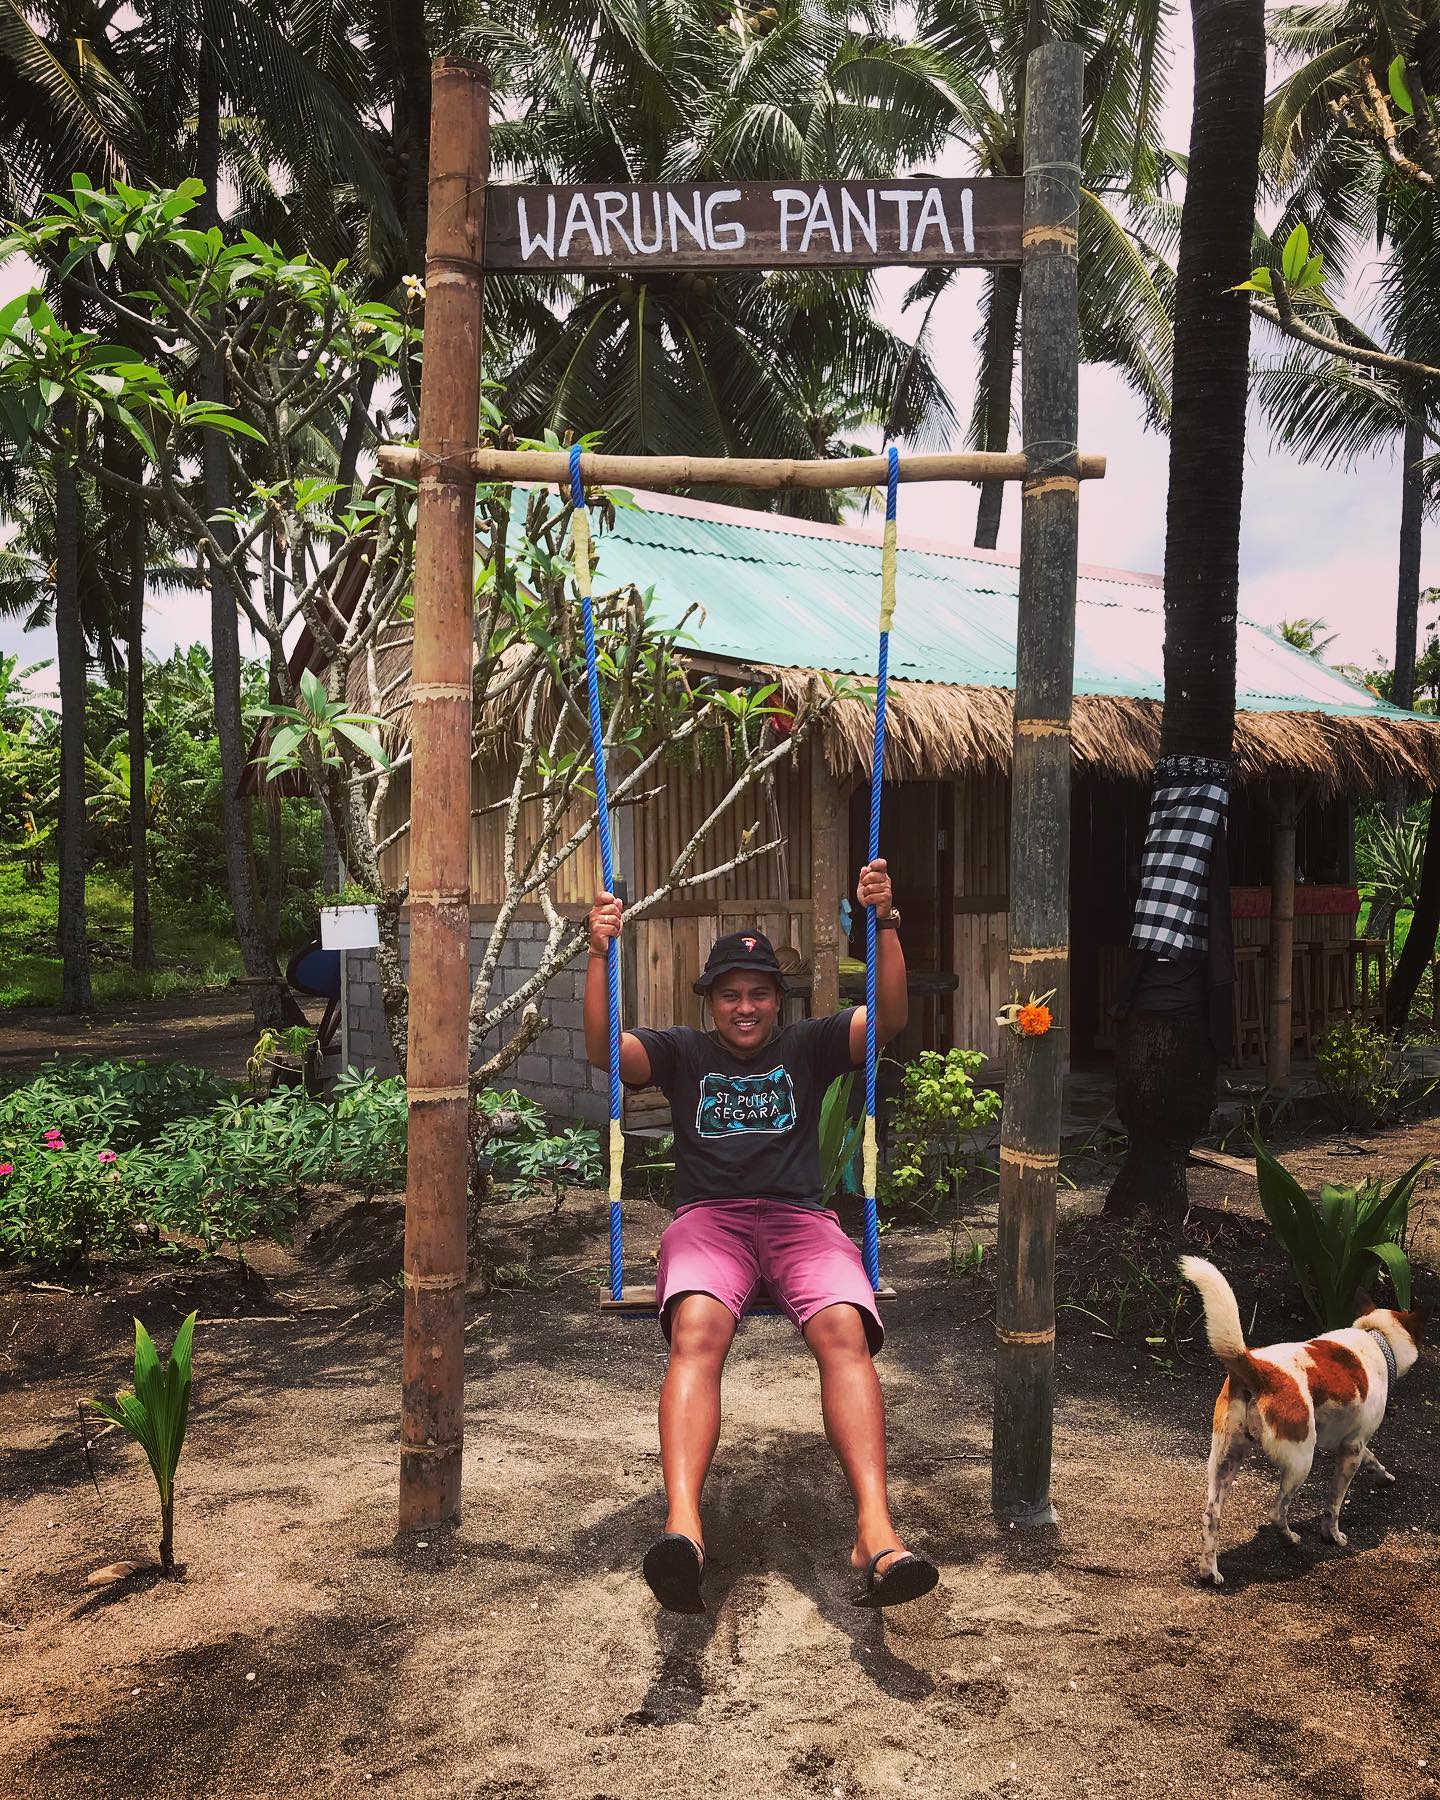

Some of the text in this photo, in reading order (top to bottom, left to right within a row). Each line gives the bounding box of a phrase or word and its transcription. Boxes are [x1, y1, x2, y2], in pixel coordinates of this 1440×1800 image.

[518, 186, 975, 261] WARUNG PANTAI
[716, 1090, 779, 1107] ST. PUTRA
[713, 1104, 780, 1120] SEGARA
